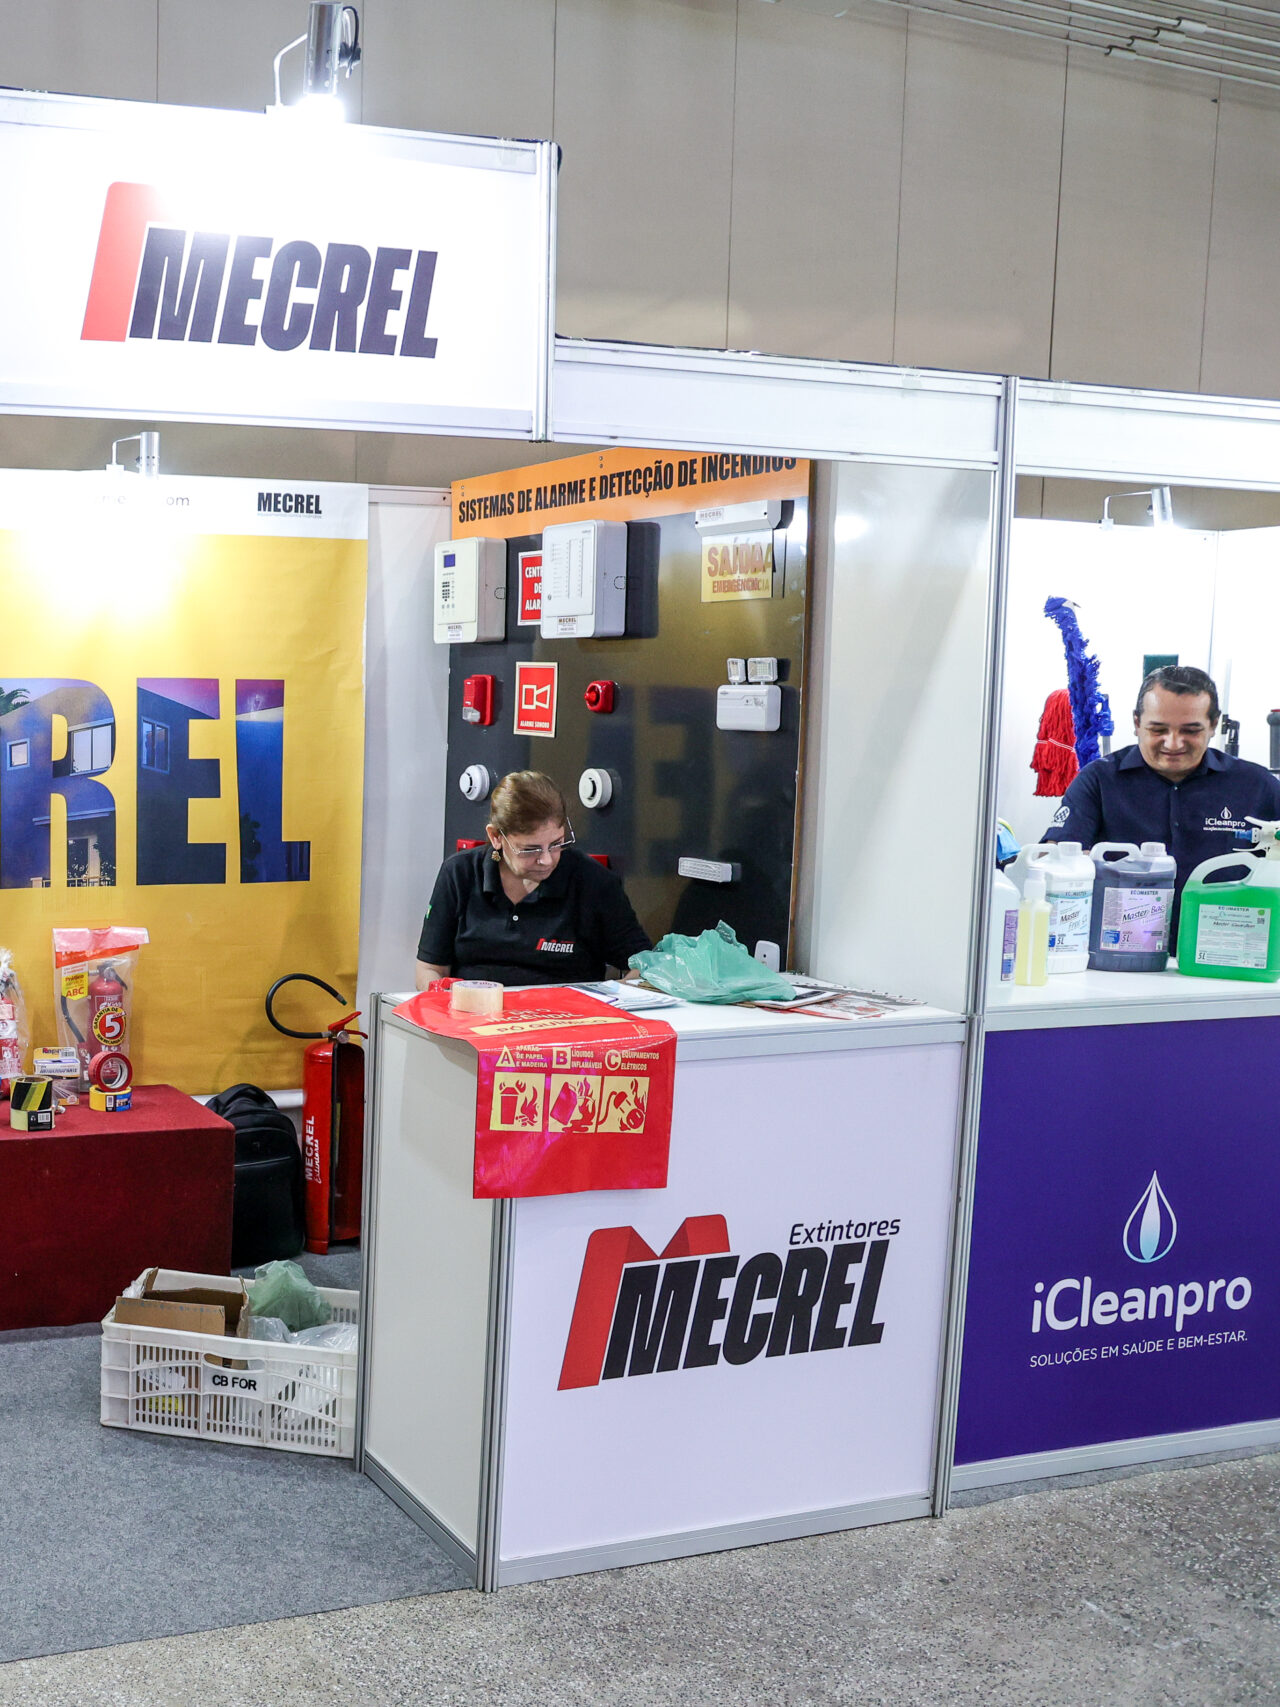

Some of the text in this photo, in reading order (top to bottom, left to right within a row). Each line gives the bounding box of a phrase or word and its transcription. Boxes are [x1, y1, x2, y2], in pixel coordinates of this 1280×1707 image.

[129, 227, 439, 359] MECREL
[458, 491, 515, 524] SISTEMAS
[517, 488, 532, 514] DE
[534, 478, 586, 511] ALARME
[588, 477, 597, 502] E
[599, 460, 674, 500] DETECÇÃO
[677, 458, 698, 487] DE
[257, 492, 323, 515] MECREL
[524, 565, 542, 578] CENT
[524, 599, 541, 611] ALAR
[1205, 817, 1246, 829] iCleanpro
[540, 941, 574, 953] MECREL
[66, 986, 85, 998] ABC
[105, 1013, 121, 1038] 5
[621, 1051, 660, 1060] EQUIPAMENTOS
[304, 1115, 315, 1181] MECREL
[788, 1217, 901, 1246] Extintores
[601, 1238, 890, 1381] MECREL
[1031, 1275, 1252, 1333] iCleanpro
[1029, 1329, 1248, 1368] SOLUÇÕES EM SAÚDE E BEM-ESTAR.
[211, 1373, 257, 1392] CB FOR
